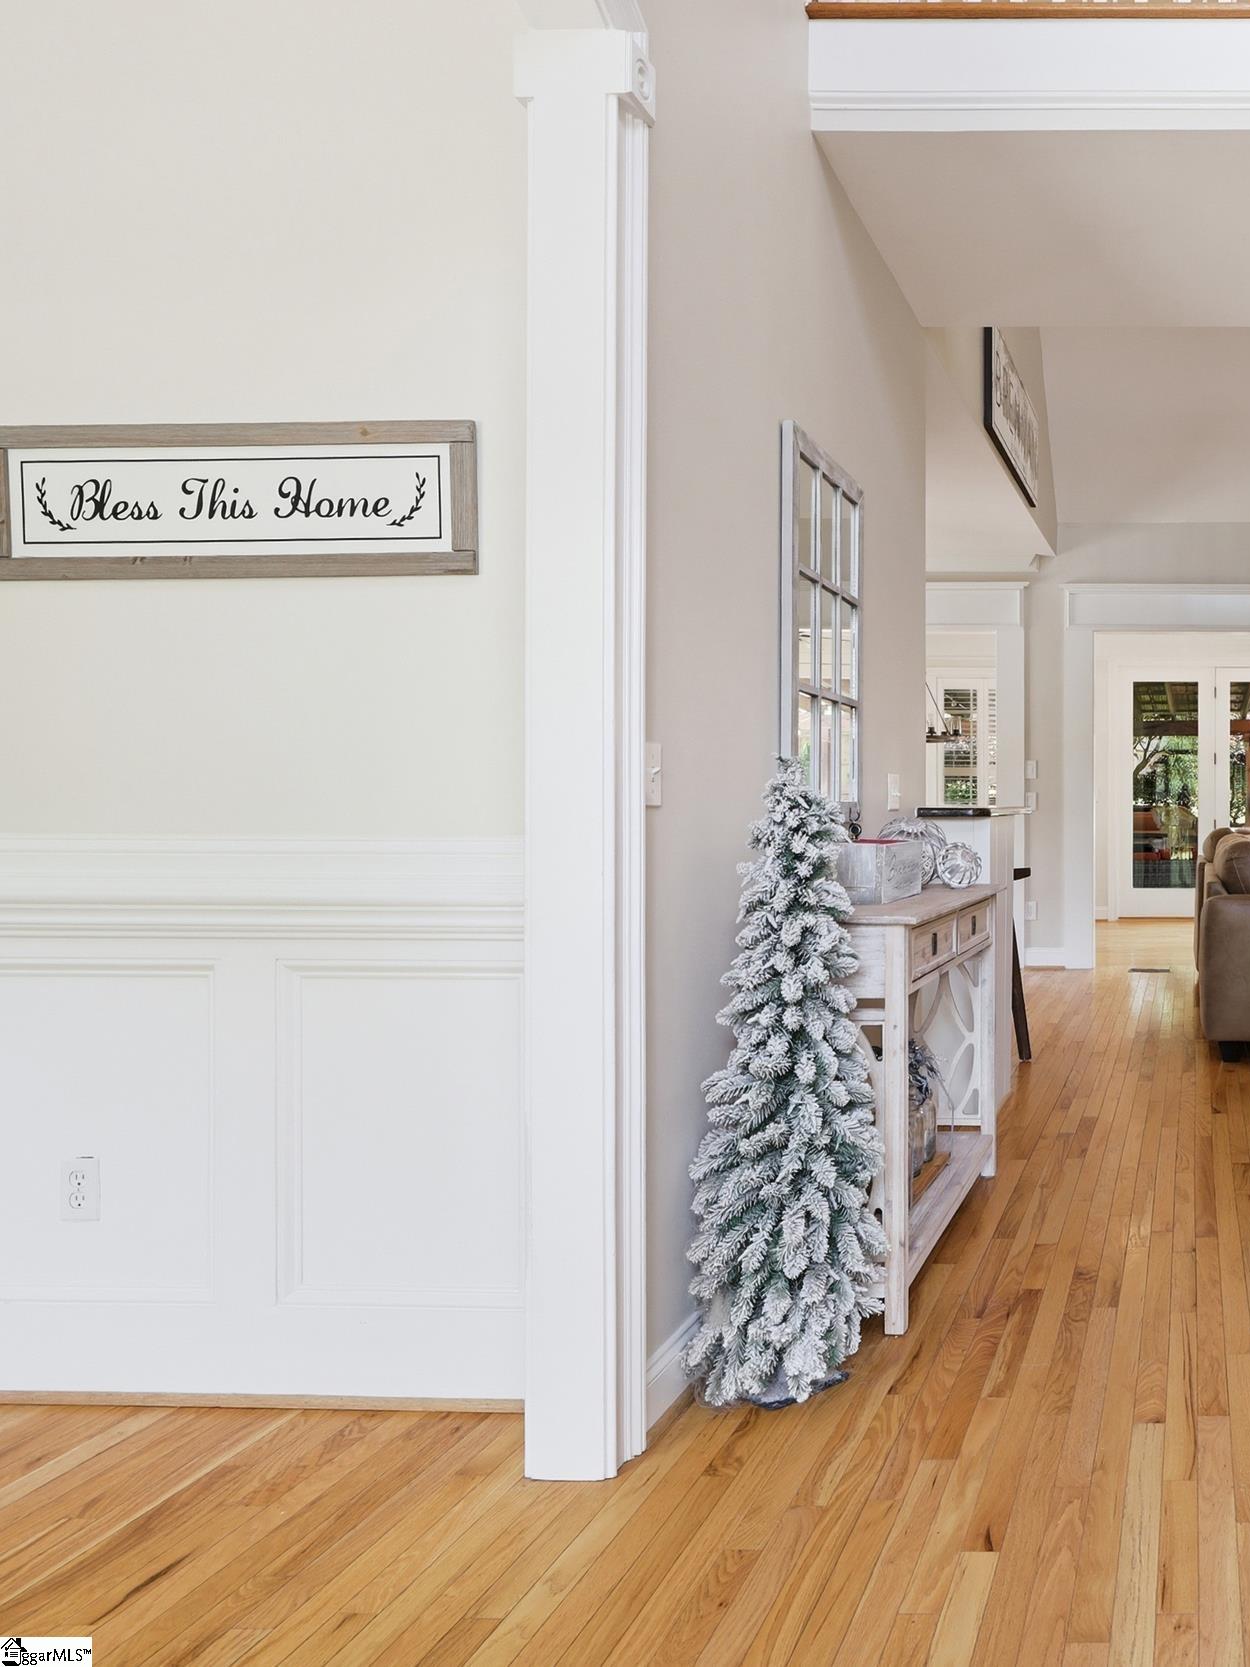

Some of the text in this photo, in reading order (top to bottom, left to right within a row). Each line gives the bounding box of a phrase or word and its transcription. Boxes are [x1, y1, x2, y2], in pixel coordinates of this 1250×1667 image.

[70, 476, 393, 521] Bless This Home
